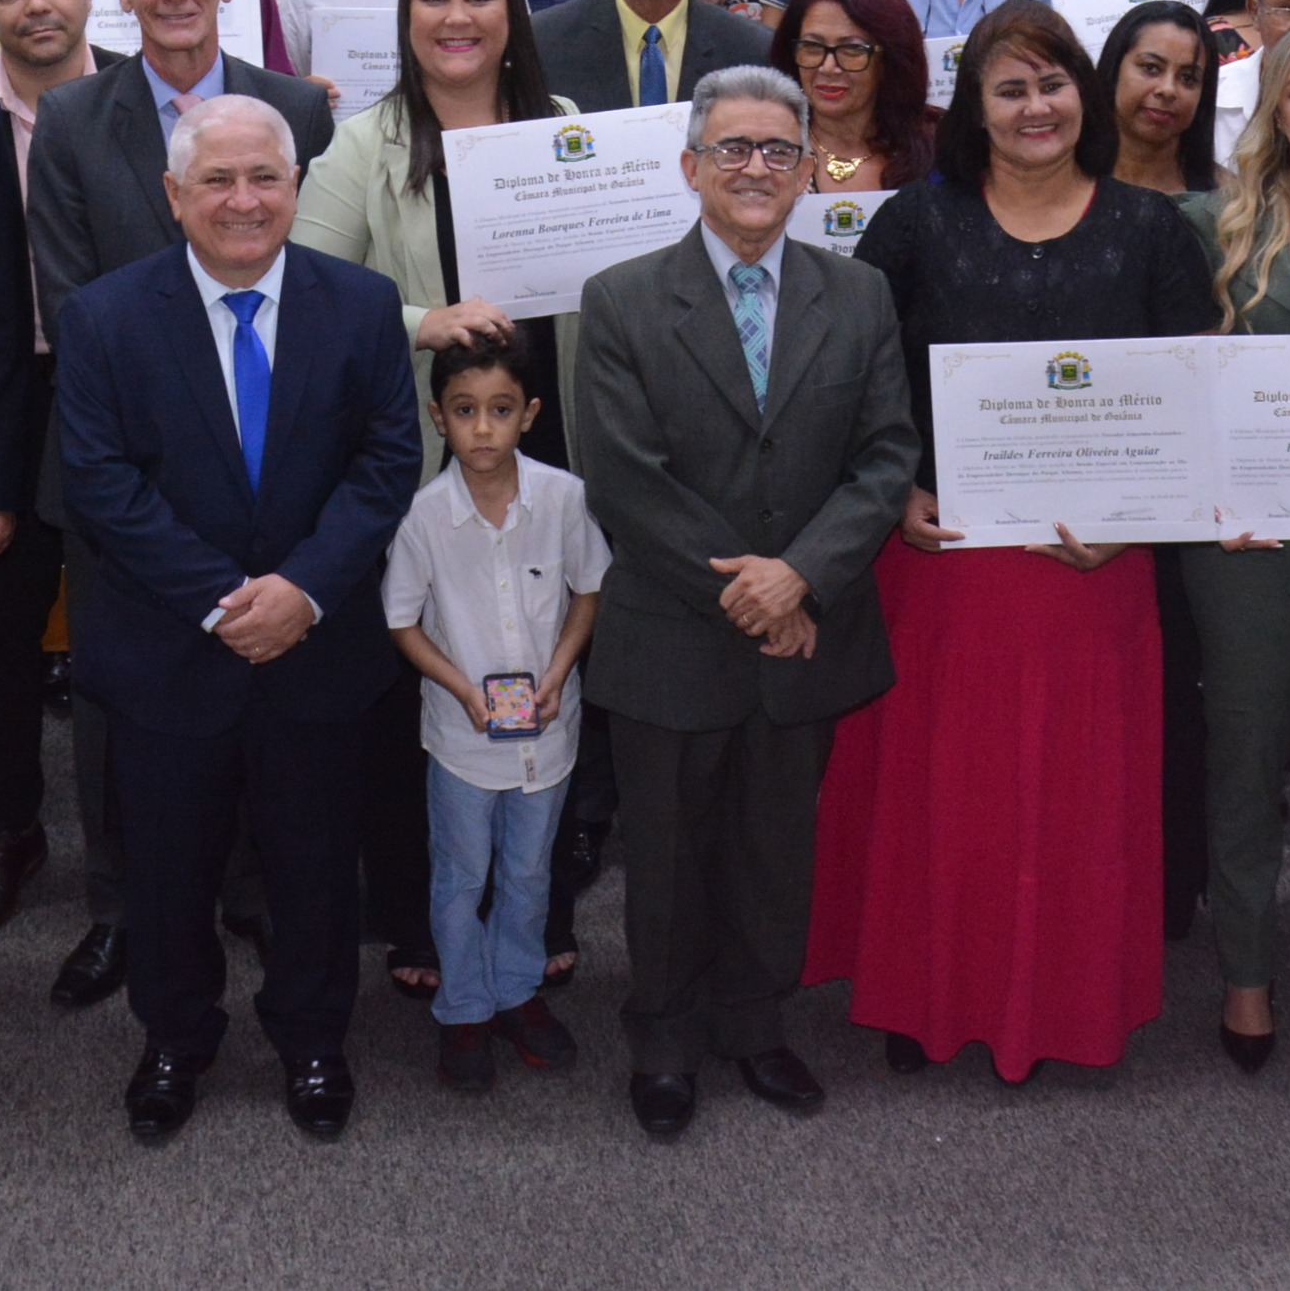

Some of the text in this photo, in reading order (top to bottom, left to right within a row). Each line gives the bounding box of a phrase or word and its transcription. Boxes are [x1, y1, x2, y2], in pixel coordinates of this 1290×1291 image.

[494, 160, 660, 189] Diploma de Honra ao Mérito
[514, 191, 549, 201] Câmara
[552, 184, 596, 197] Municipal
[610, 178, 644, 189] Goiânia
[492, 228, 534, 240] Lorenna
[588, 214, 629, 227] Ferreira
[632, 212, 643, 221] de
[646, 209, 671, 219] Lima
[979, 399, 1033, 411] Diploma
[1037, 399, 1050, 409] de
[1055, 397, 1095, 408] Honra
[1119, 393, 1162, 406] Mérito
[999, 411, 1142, 424] Câmara Municipal de Goiânia
[984, 446, 1160, 460] Iraildes Ferreira Oliveira Aguiar
